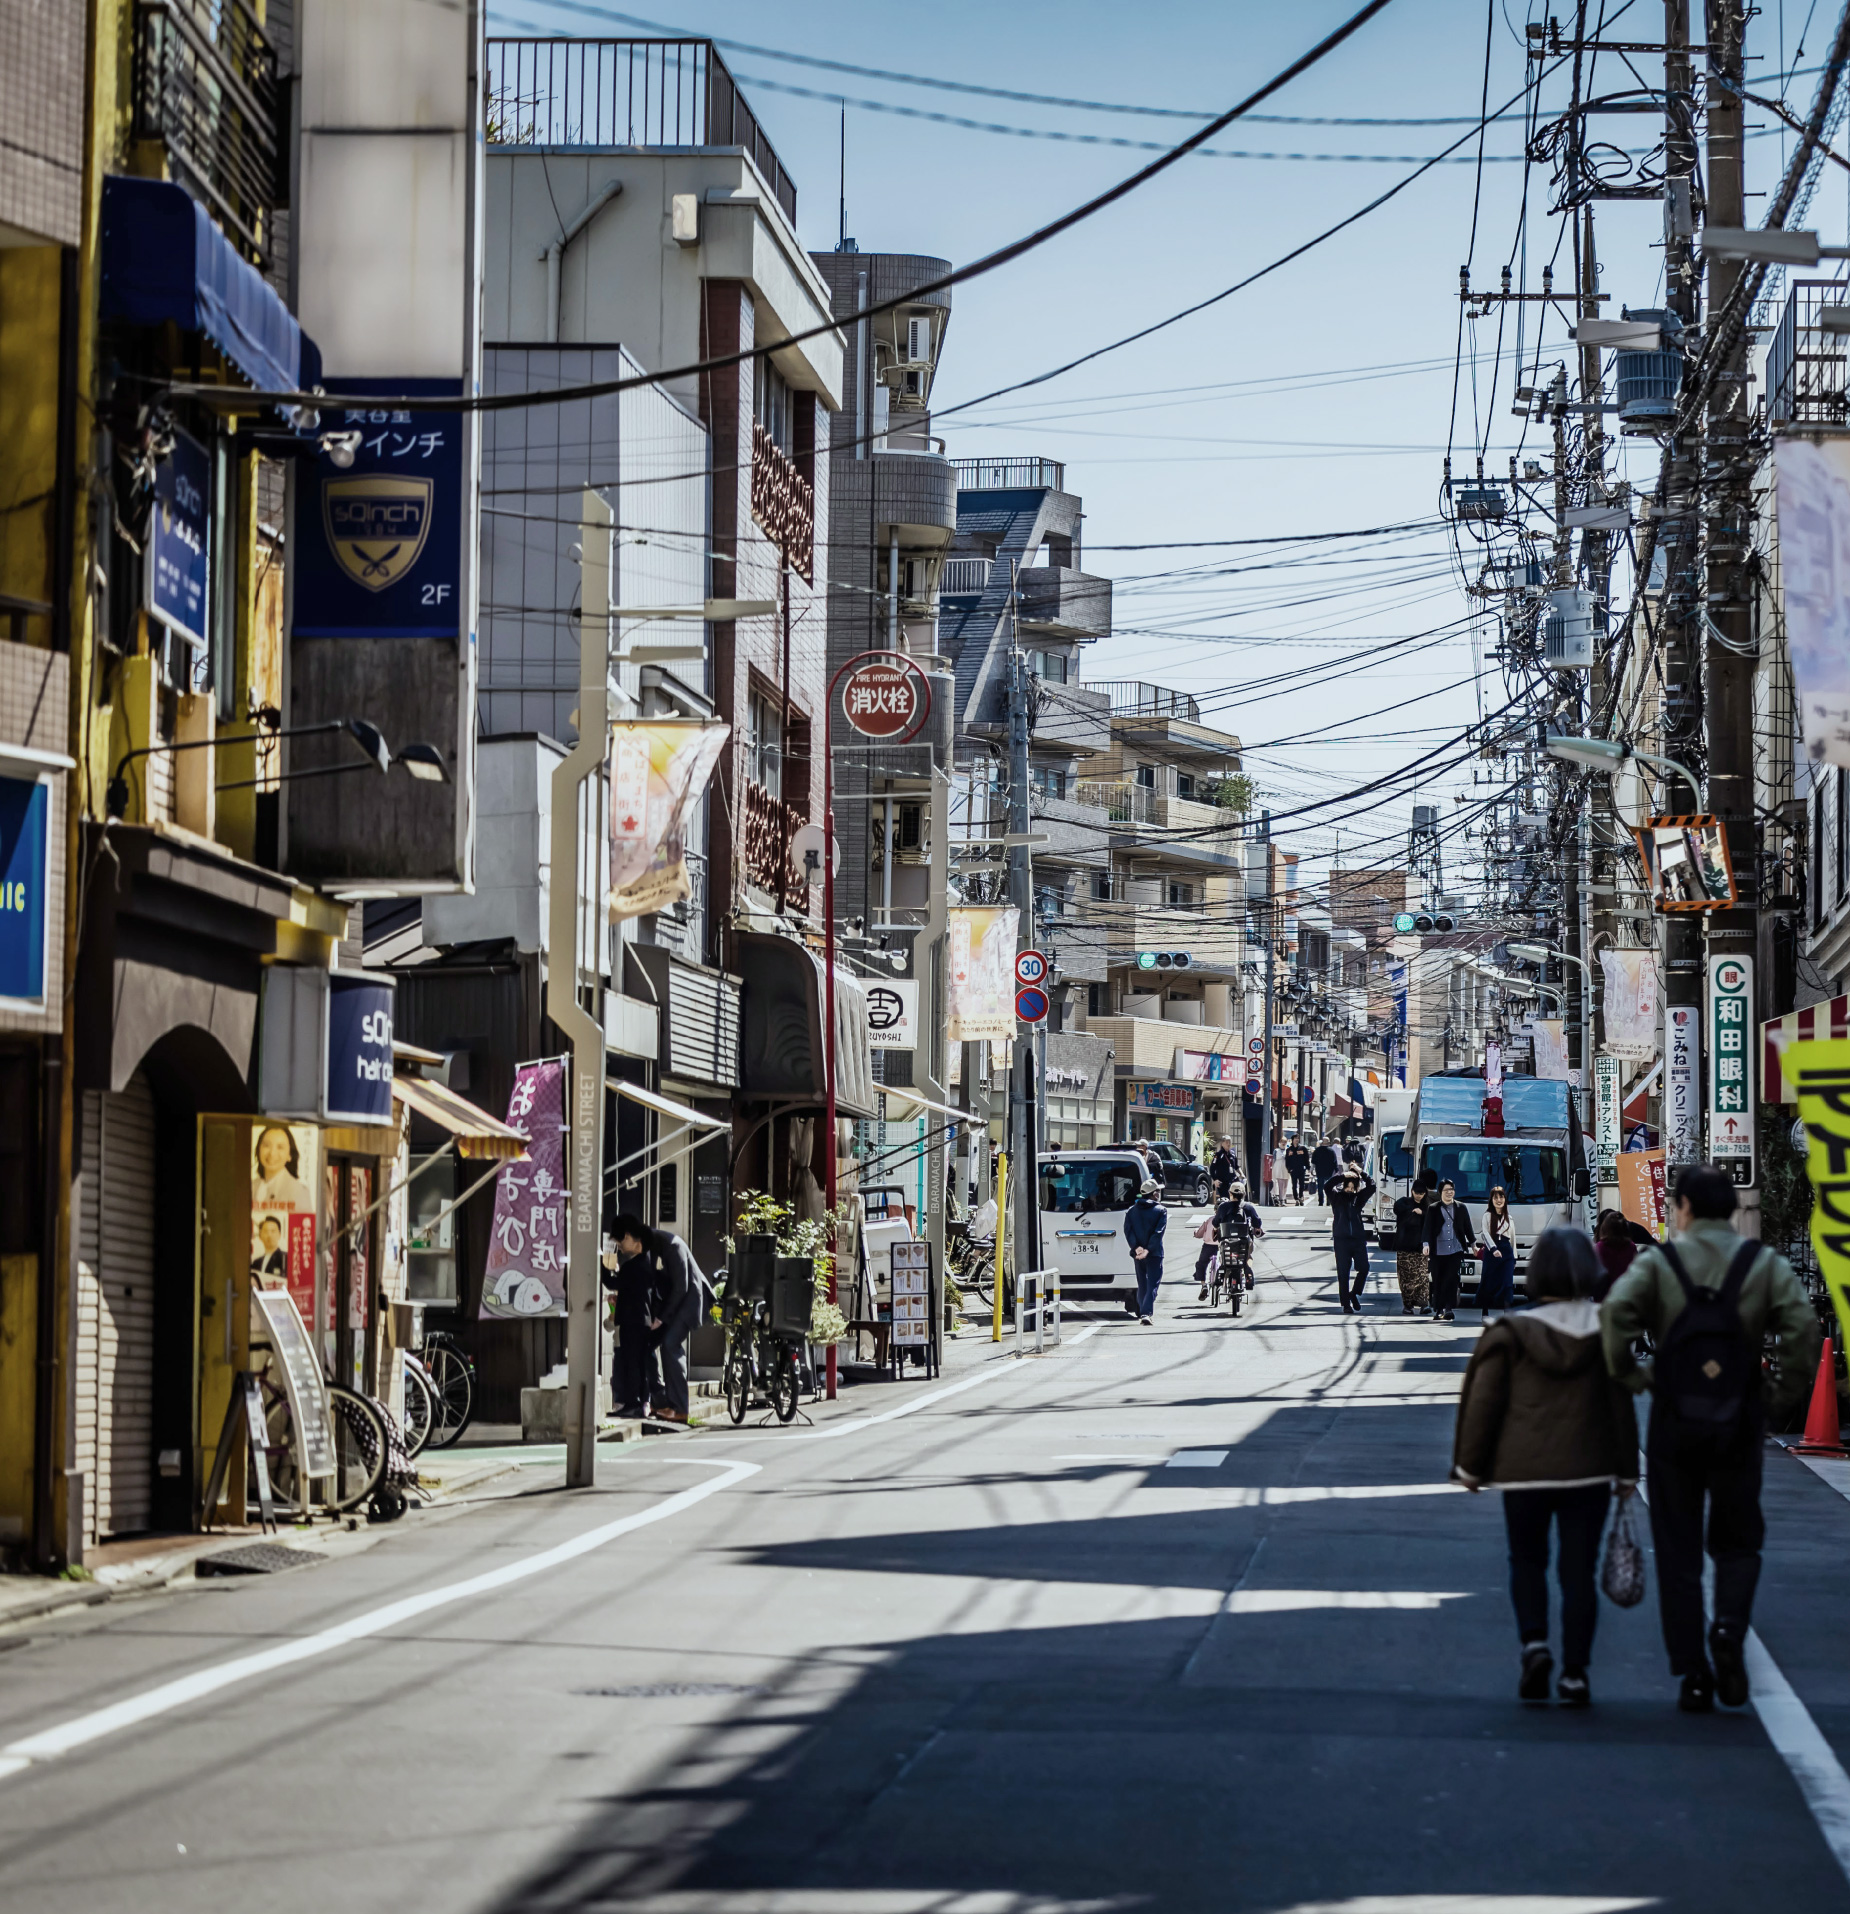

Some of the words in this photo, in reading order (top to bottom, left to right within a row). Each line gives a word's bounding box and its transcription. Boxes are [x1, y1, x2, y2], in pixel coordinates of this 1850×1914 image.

[421, 584, 451, 605] 2F
[856, 674, 871, 683] FIRE
[872, 673, 903, 682] HYDRANT
[851, 686, 910, 714] 消火栓
[1021, 960, 1041, 976] 30
[1724, 971, 1738, 983] 眼
[1252, 1041, 1262, 1050] 30
[1673, 1028, 1688, 1066] こみね
[1718, 998, 1743, 1110] 和田眼科
[357, 1054, 382, 1081] hair
[579, 1072, 595, 1127] STREET
[1147, 1085, 1194, 1110] カード会員募集中
[1601, 1075, 1612, 1143] 学習館・アシスト
[1674, 1084, 1687, 1138] クリニック
[1714, 1135, 1749, 1143] すぐ先左側
[577, 1131, 593, 1233] EBARAMACHI
[931, 1152, 941, 1214] EBARAMACHI
[530, 1167, 560, 1272] 専門店
[1077, 1244, 1099, 1253] 38-94
